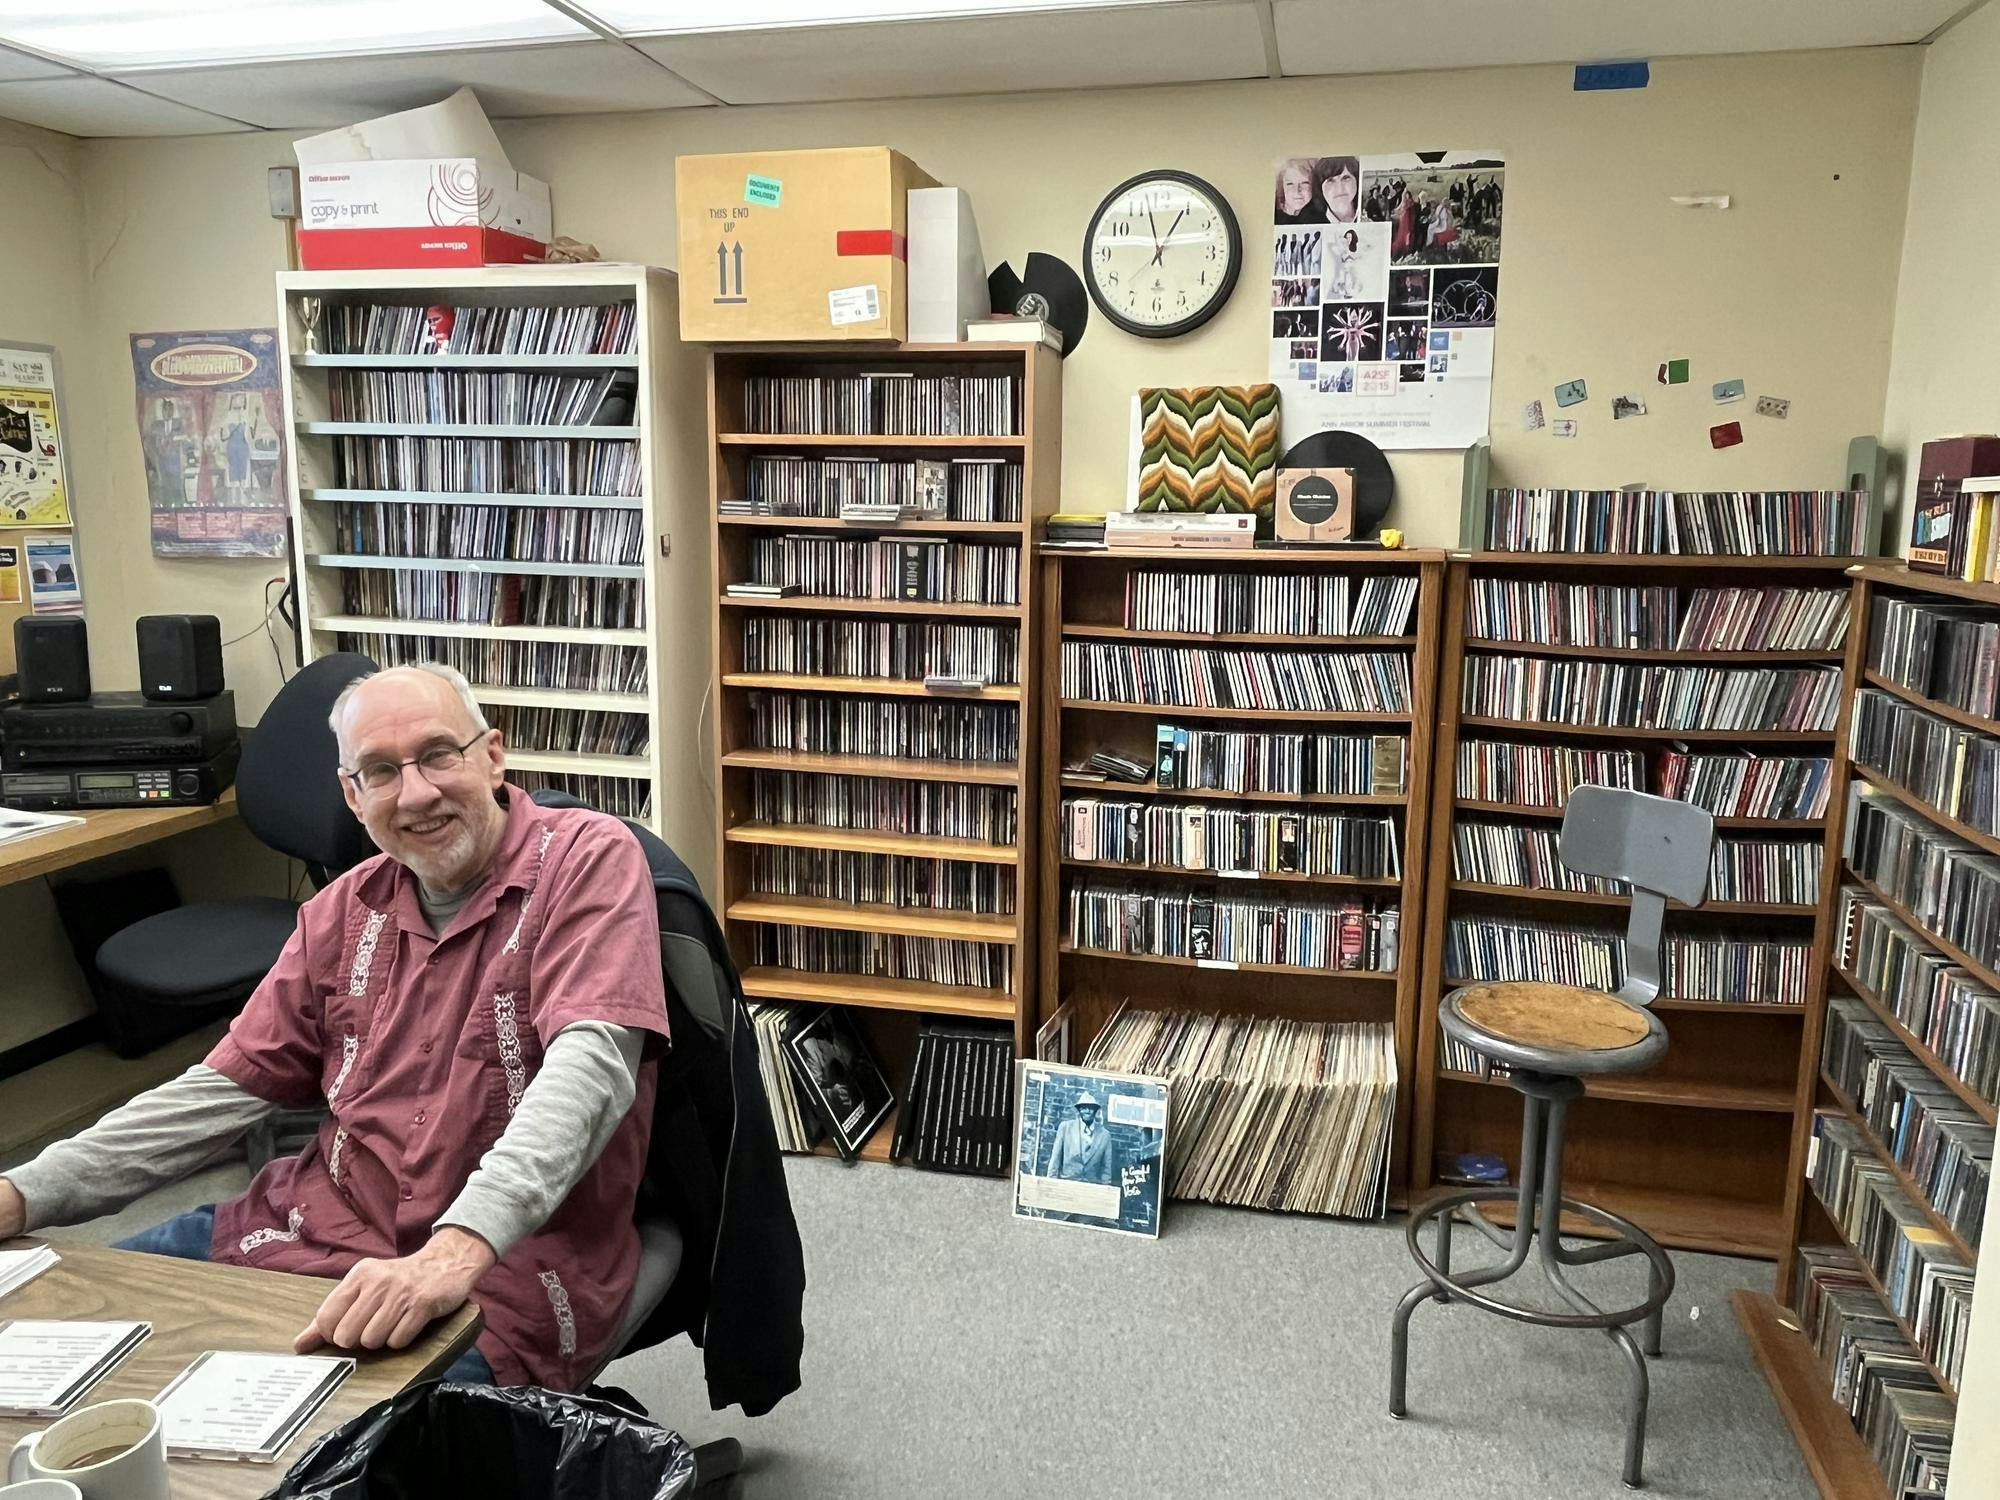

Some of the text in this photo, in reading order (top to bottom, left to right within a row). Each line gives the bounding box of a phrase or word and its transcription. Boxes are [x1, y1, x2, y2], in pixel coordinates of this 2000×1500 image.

[311, 204, 340, 220] copy
[350, 202, 379, 218] print
[709, 207, 749, 219] THIS END
[1129, 200, 1144, 217] 11
[723, 222, 735, 233] UP
[1112, 221, 1130, 237] 10
[1101, 246, 1112, 262] 9
[1205, 245, 1216, 261] 3
[1108, 271, 1119, 287] 8
[1197, 270, 1205, 286] 4
[1128, 290, 1137, 306] 7
[1152, 297, 1162, 313] 6
[1176, 290, 1186, 306] 5
[1363, 369, 1390, 380] A2SF
[1366, 420, 1398, 428] SUMMER
[1399, 420, 1431, 428] FESTIVAL
